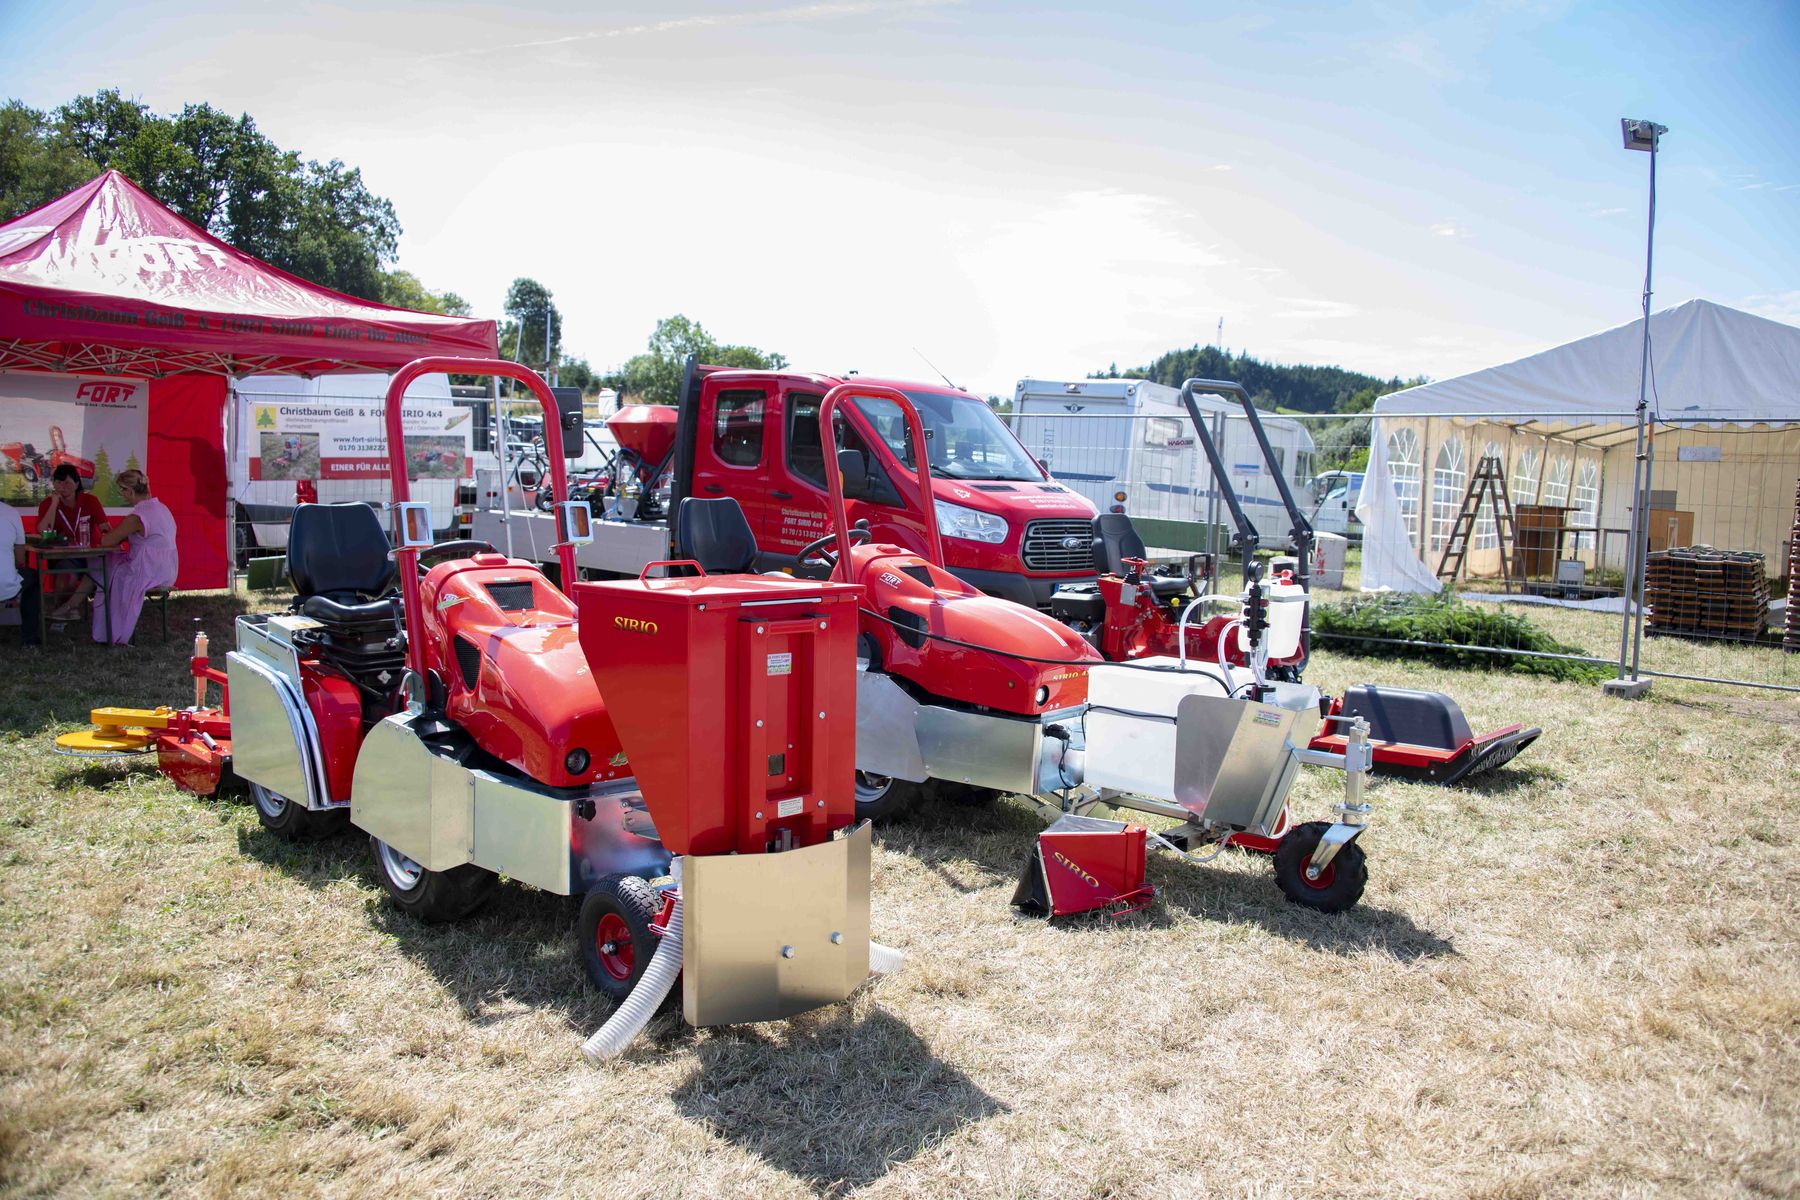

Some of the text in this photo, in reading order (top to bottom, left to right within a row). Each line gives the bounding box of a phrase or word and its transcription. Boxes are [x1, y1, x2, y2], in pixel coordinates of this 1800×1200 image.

[23, 300, 139, 325] Christbaum
[145, 309, 185, 329] Geiß
[197, 317, 210, 331] &
[221, 317, 264, 334] FORT
[323, 324, 361, 341] Einer
[367, 327, 388, 342] für
[393, 330, 431, 346] alles!
[76, 381, 136, 403] FORT
[280, 406, 331, 417] Christbaum
[334, 407, 354, 417] Geiß
[359, 409, 365, 417] &
[426, 410, 443, 419] 4x4
[333, 436, 388, 444] www.fort-sirio.d
[338, 444, 355, 452] 0170
[330, 462, 391, 472] EINER FÜR ALLE
[784, 517, 823, 528] FORT SIRIO 4x4
[880, 572, 903, 586] FORT
[614, 616, 658, 635] SIRIO
[1053, 671, 1079, 681] SIRIO
[1054, 851, 1099, 888] SIRIO
